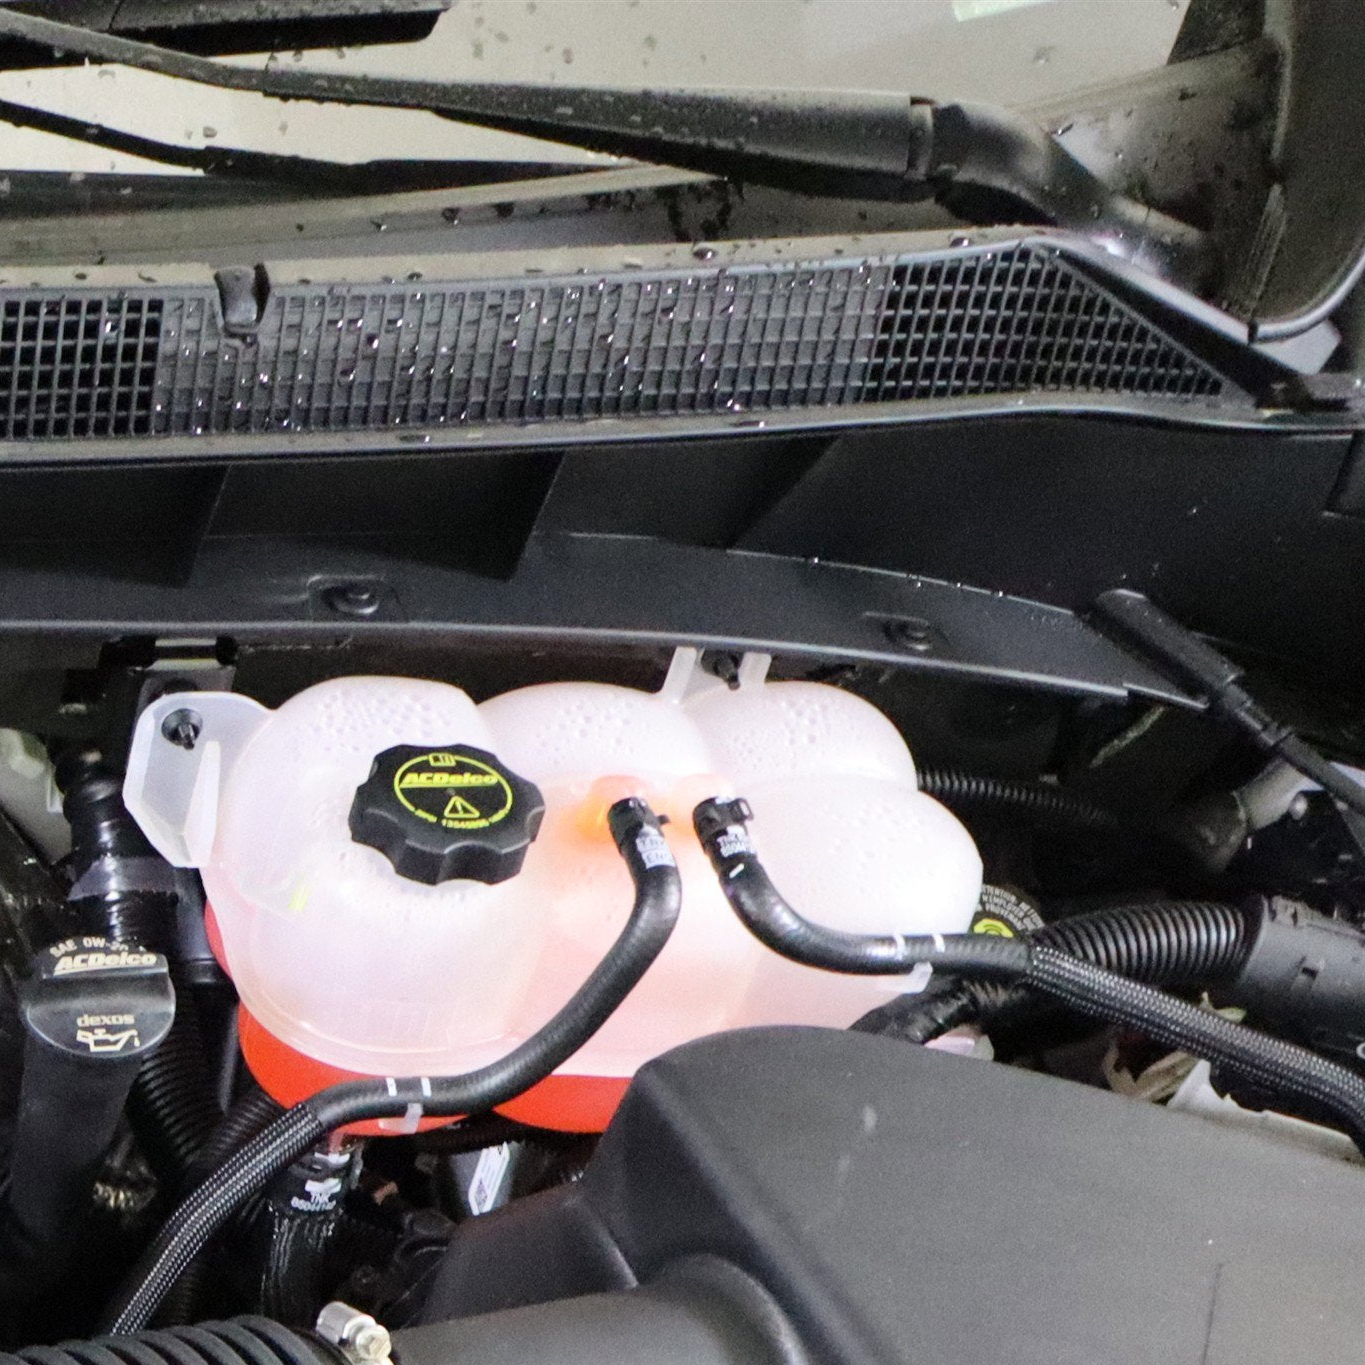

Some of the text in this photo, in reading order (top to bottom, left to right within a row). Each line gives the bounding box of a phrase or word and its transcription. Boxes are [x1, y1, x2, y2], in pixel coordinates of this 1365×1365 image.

[399, 772, 499, 787] ACDelco
[50, 939, 77, 957] SAE
[54, 952, 157, 973] ACDelco
[76, 1014, 135, 1027] dexos
